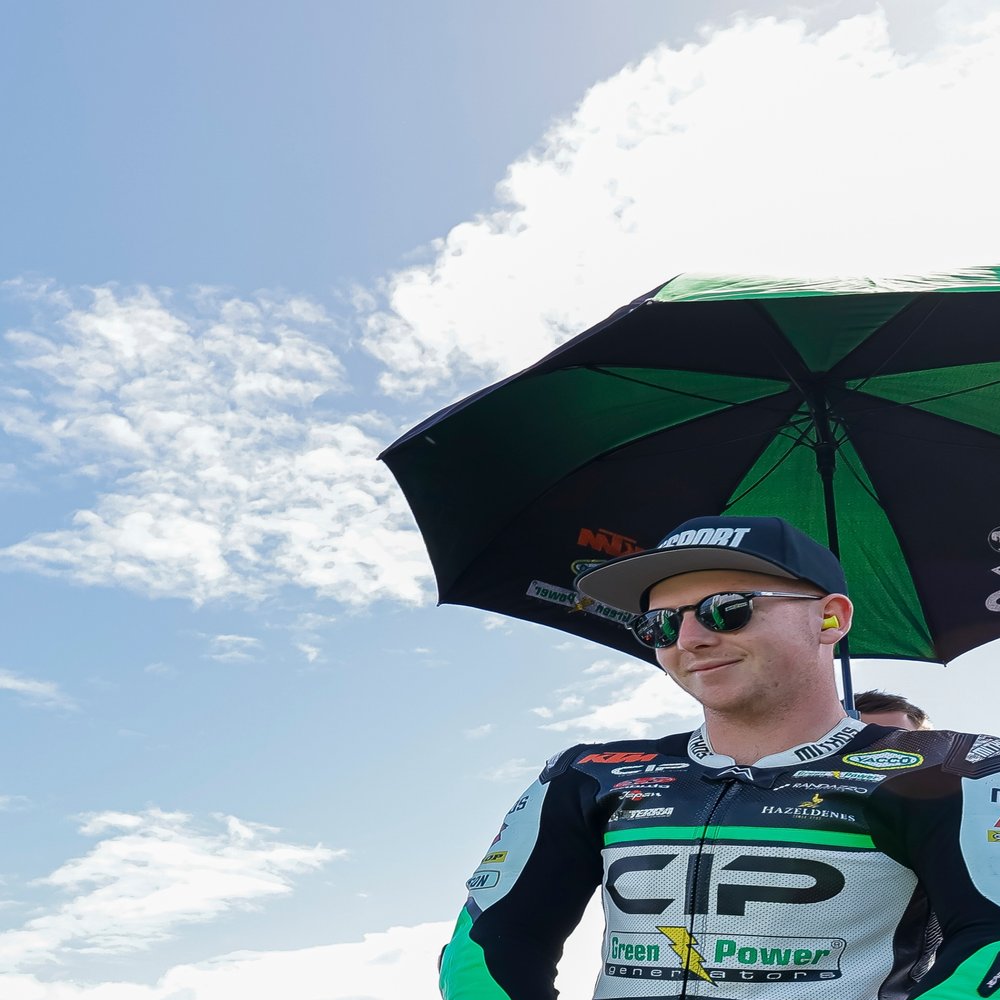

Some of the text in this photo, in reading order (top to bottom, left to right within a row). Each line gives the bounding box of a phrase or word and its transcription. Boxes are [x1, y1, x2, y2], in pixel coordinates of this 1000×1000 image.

[794, 726, 858, 762] MITHOS
[577, 752, 658, 764] KTM
[857, 756, 915, 764] YACCO
[611, 763, 690, 775] CIP
[761, 806, 856, 822] HAZELDENES
[606, 854, 844, 917] CIP
[612, 936, 831, 966] Green Power
[608, 966, 836, 980] generators
